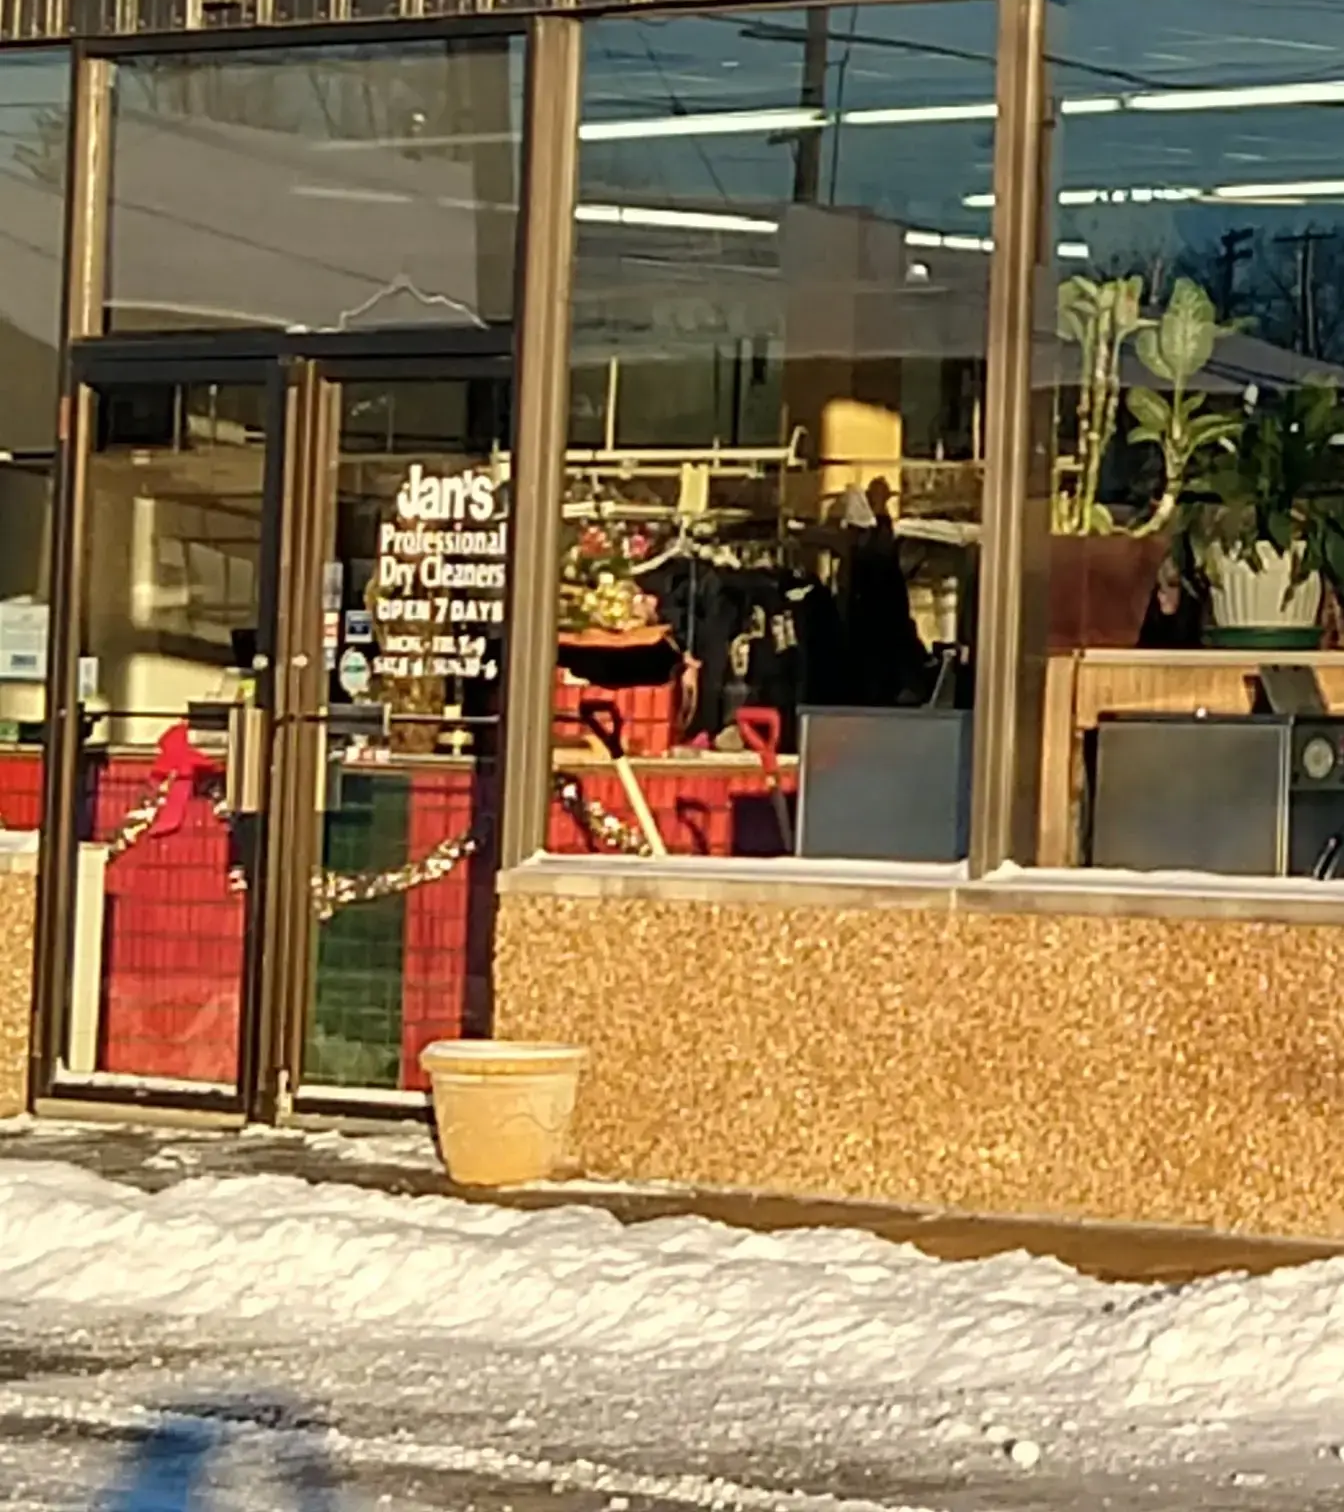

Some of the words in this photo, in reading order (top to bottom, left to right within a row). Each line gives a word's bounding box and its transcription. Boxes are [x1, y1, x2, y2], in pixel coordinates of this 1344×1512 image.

[398, 464, 494, 520] Jan's
[380, 522, 506, 556] Professional
[379, 556, 415, 595] Dry
[420, 555, 505, 588] Cleaners
[377, 597, 431, 621] OPEN
[434, 597, 449, 623] 7
[451, 600, 504, 623] DAYS
